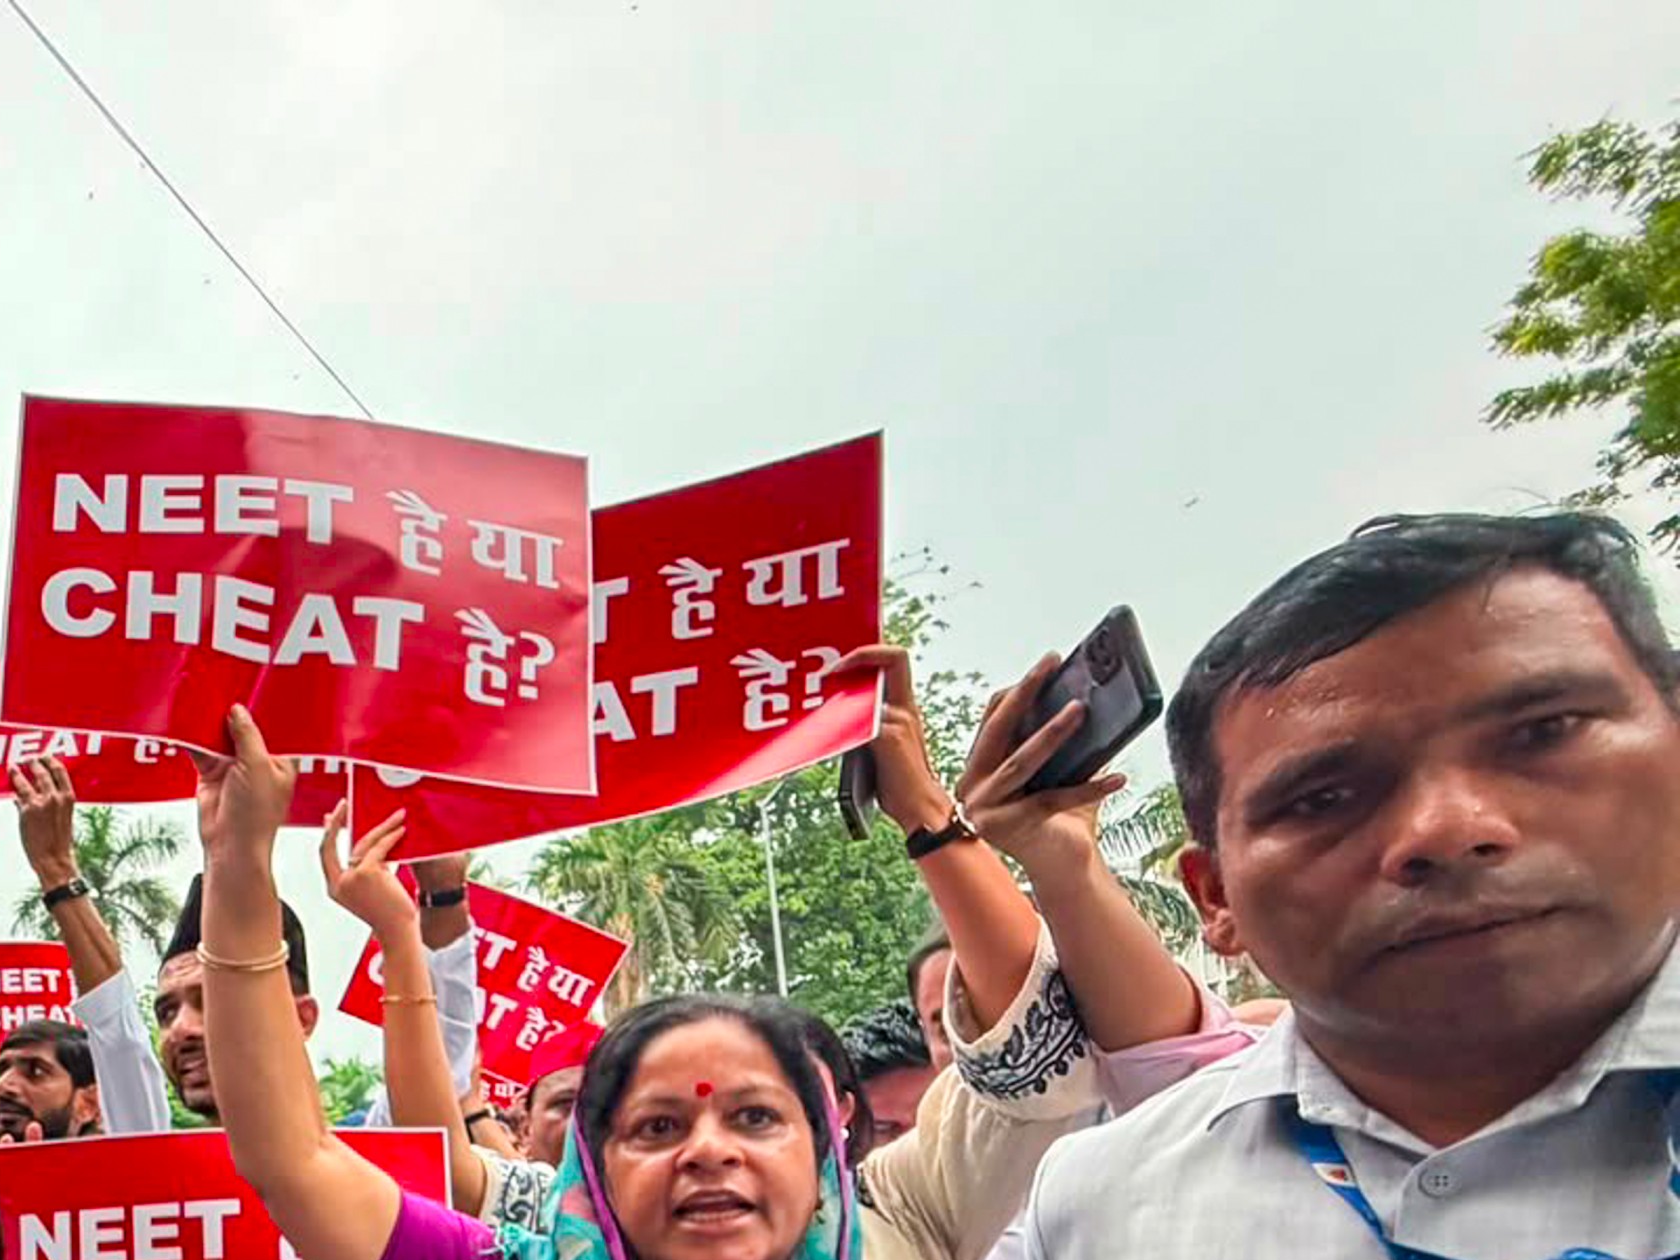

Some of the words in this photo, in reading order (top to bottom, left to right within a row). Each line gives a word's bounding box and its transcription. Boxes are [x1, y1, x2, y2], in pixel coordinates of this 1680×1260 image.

[53, 474, 353, 545] NEET
[385, 490, 448, 577] है
[467, 520, 565, 590] या
[41, 568, 425, 672] CHEAT
[453, 606, 557, 707] है?
[658, 556, 724, 641] है
[742, 538, 851, 608] या
[729, 647, 843, 732] है?
[516, 945, 551, 993] है
[548, 965, 595, 1008] या
